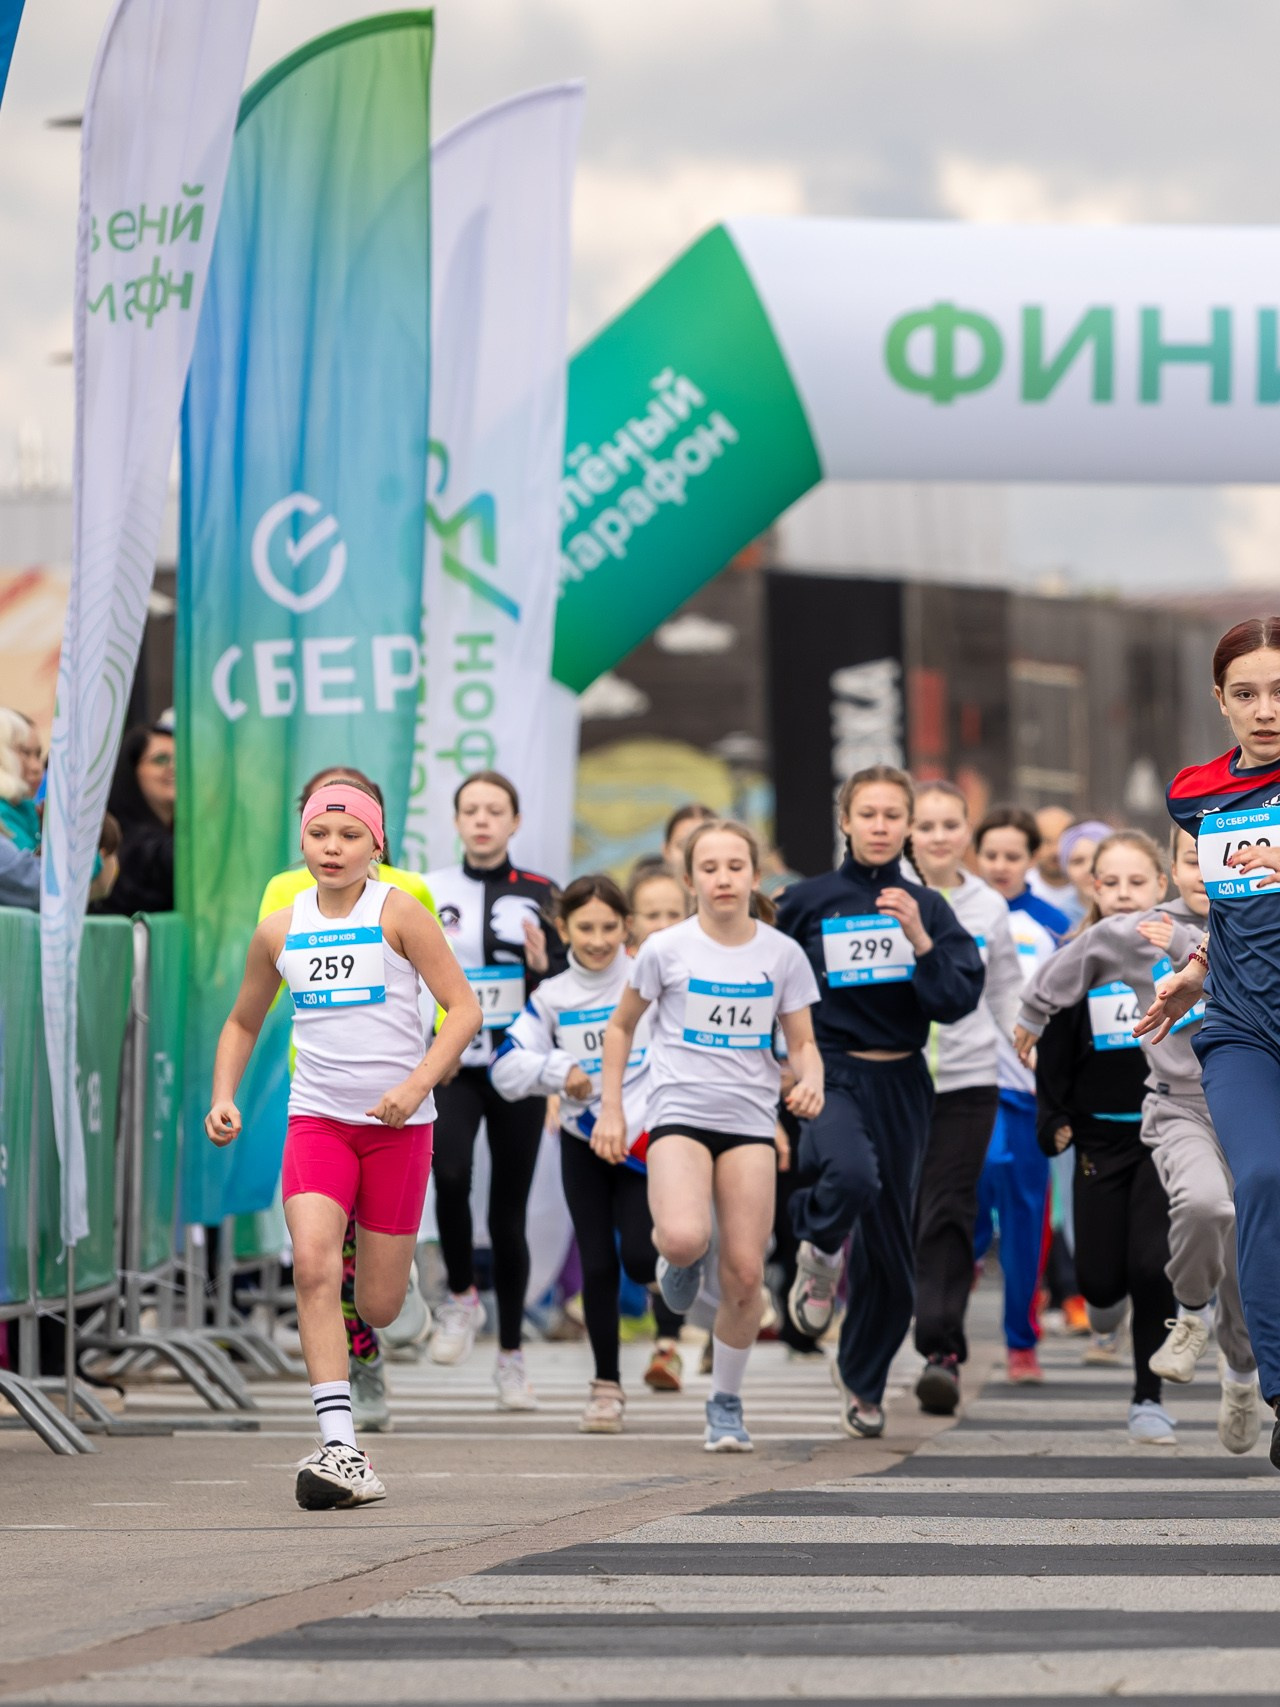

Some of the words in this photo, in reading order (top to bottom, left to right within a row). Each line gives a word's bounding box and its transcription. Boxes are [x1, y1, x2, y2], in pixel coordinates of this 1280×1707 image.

[558, 366, 706, 526] лёный
[211, 634, 421, 722] СБЕР
[1225, 816, 1249, 826] СБЕР
[1249, 813, 1270, 823] KIDS
[1218, 882, 1235, 895] 420
[849, 937, 893, 961] 299
[309, 954, 355, 982] 259
[302, 993, 318, 1005] 420
[708, 1004, 752, 1027] 414
